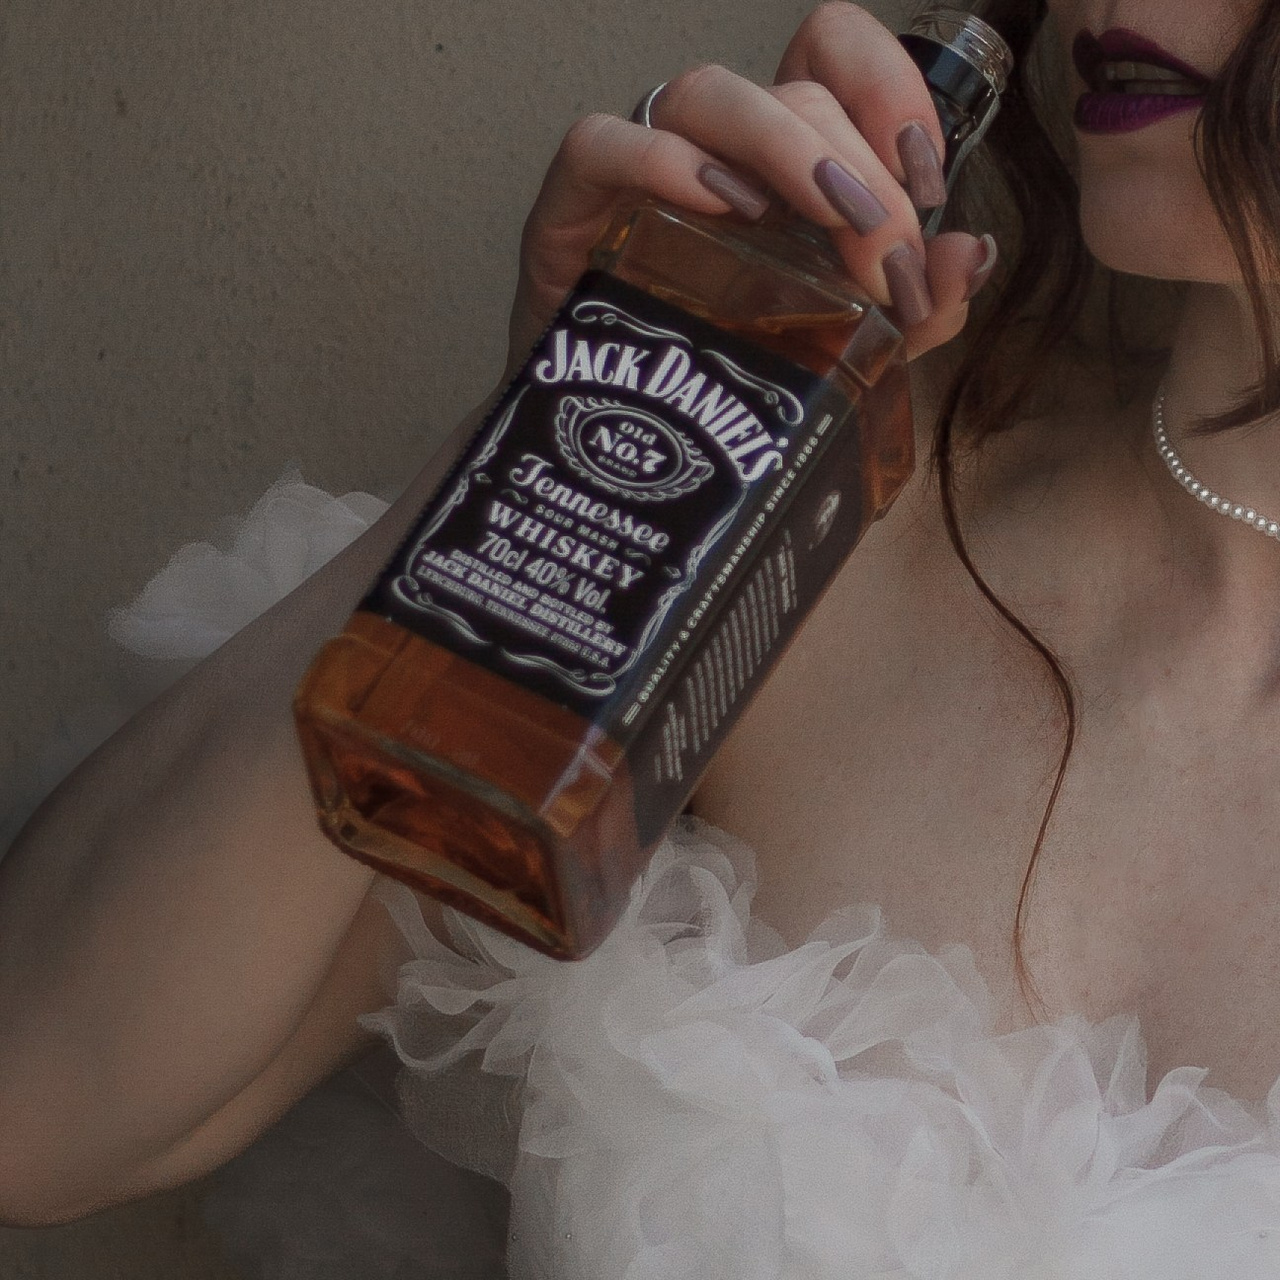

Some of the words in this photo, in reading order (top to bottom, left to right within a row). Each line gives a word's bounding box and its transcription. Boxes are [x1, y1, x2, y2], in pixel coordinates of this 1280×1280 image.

[535, 329, 652, 391] JACK
[642, 344, 789, 483] DANIEL'S
[619, 421, 658, 446] Old
[487, 500, 645, 590] WHISKEY
[509, 453, 670, 553] Tennessee
[535, 504, 573, 529] SOUR
[577, 524, 619, 551] MASH
[422, 550, 467, 579] JACK
[467, 572, 529, 610] DANIEL
[529, 605, 628, 658] DISTILLERY
[477, 531, 529, 572] 70cl
[524, 557, 574, 595] 40%
[573, 577, 612, 614] Vol.
[638, 640, 681, 702] QUALITY
[687, 512, 766, 629] CRAFTSMANSHIP
[764, 469, 797, 513] SINCE
